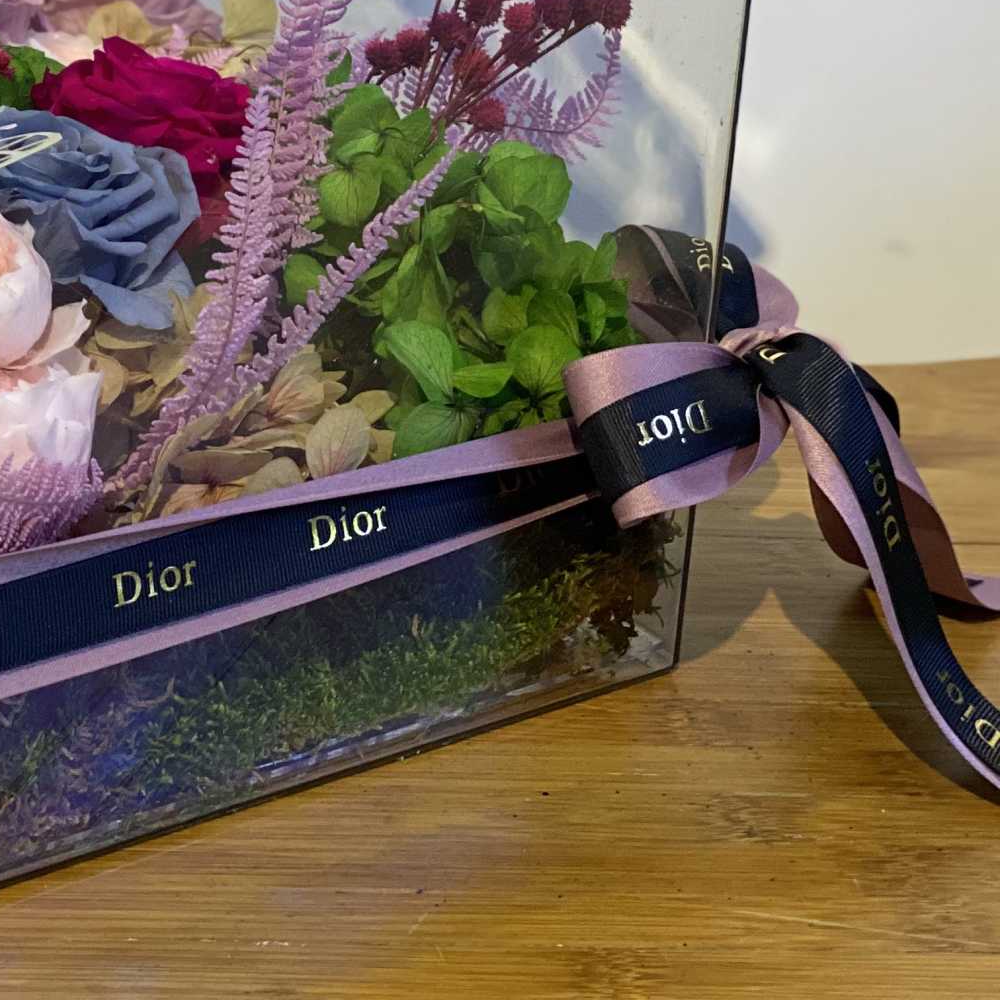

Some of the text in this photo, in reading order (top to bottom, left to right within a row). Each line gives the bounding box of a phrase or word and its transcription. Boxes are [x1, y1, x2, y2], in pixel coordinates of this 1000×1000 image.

[636, 399, 711, 447] Dior
[865, 459, 900, 552] Dior
[112, 559, 197, 607] Dior
[308, 505, 388, 552] Dior
[936, 669, 1000, 748] Dior
